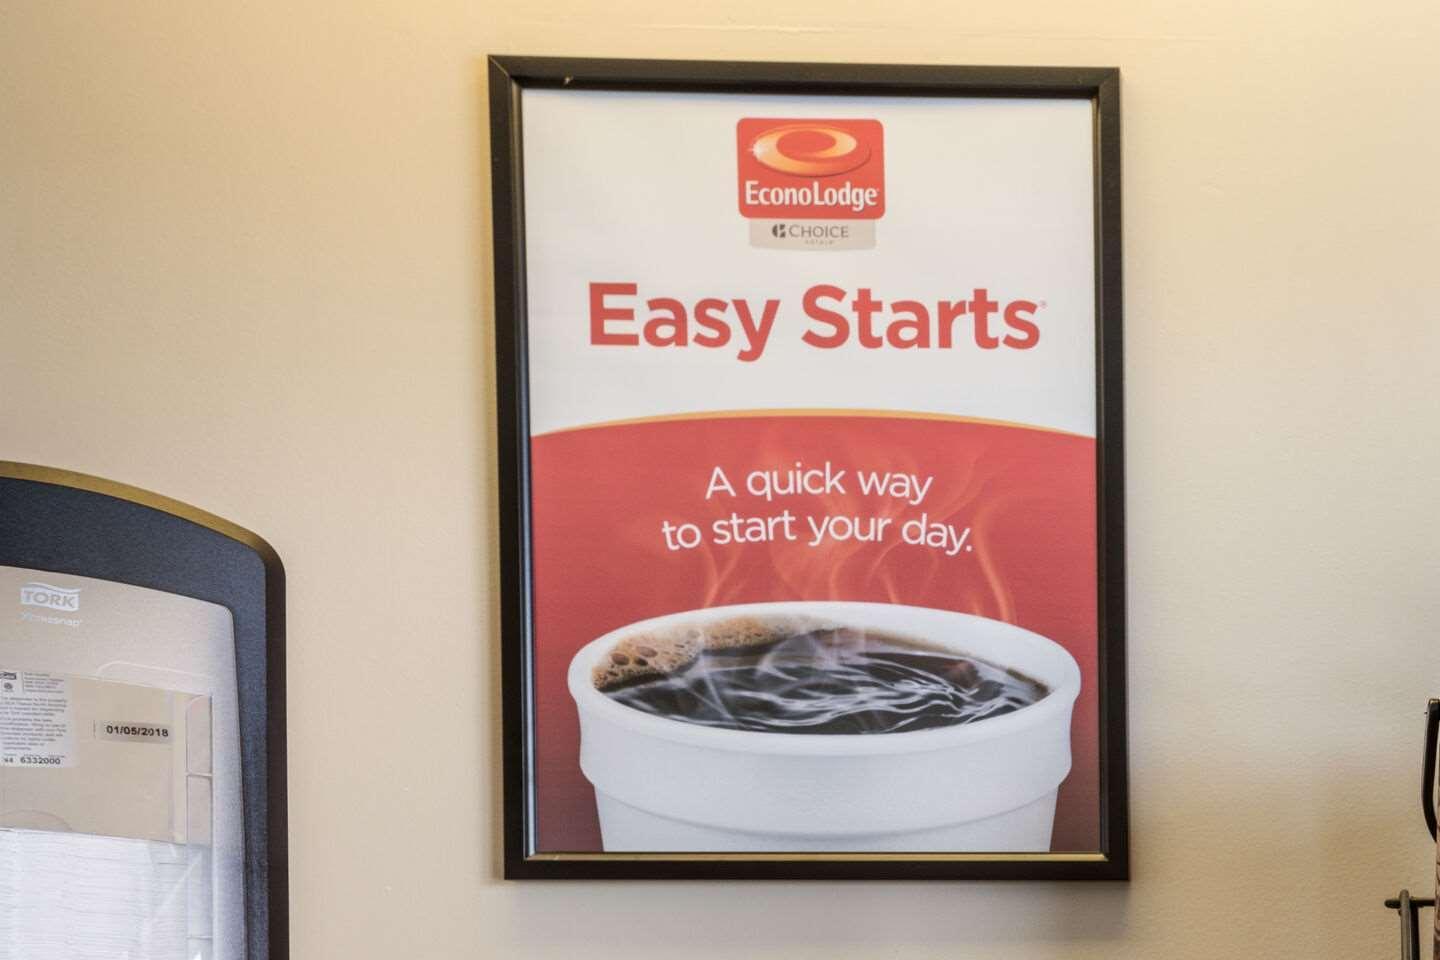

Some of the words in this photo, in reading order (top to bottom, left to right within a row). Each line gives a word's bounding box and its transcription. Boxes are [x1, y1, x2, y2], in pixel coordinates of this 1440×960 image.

[745, 180, 878, 212] EconoLodge
[788, 224, 849, 239] CHOICE
[588, 282, 780, 362] Easy
[801, 284, 1041, 350] Starts
[705, 466, 736, 500] A
[746, 462, 847, 499] quick
[857, 473, 934, 505] way
[662, 519, 702, 551] to
[712, 511, 798, 545] start
[807, 513, 892, 545] your
[901, 513, 974, 556] day.
[23, 588, 76, 609] TORK
[106, 724, 169, 738] 01/05/2018
